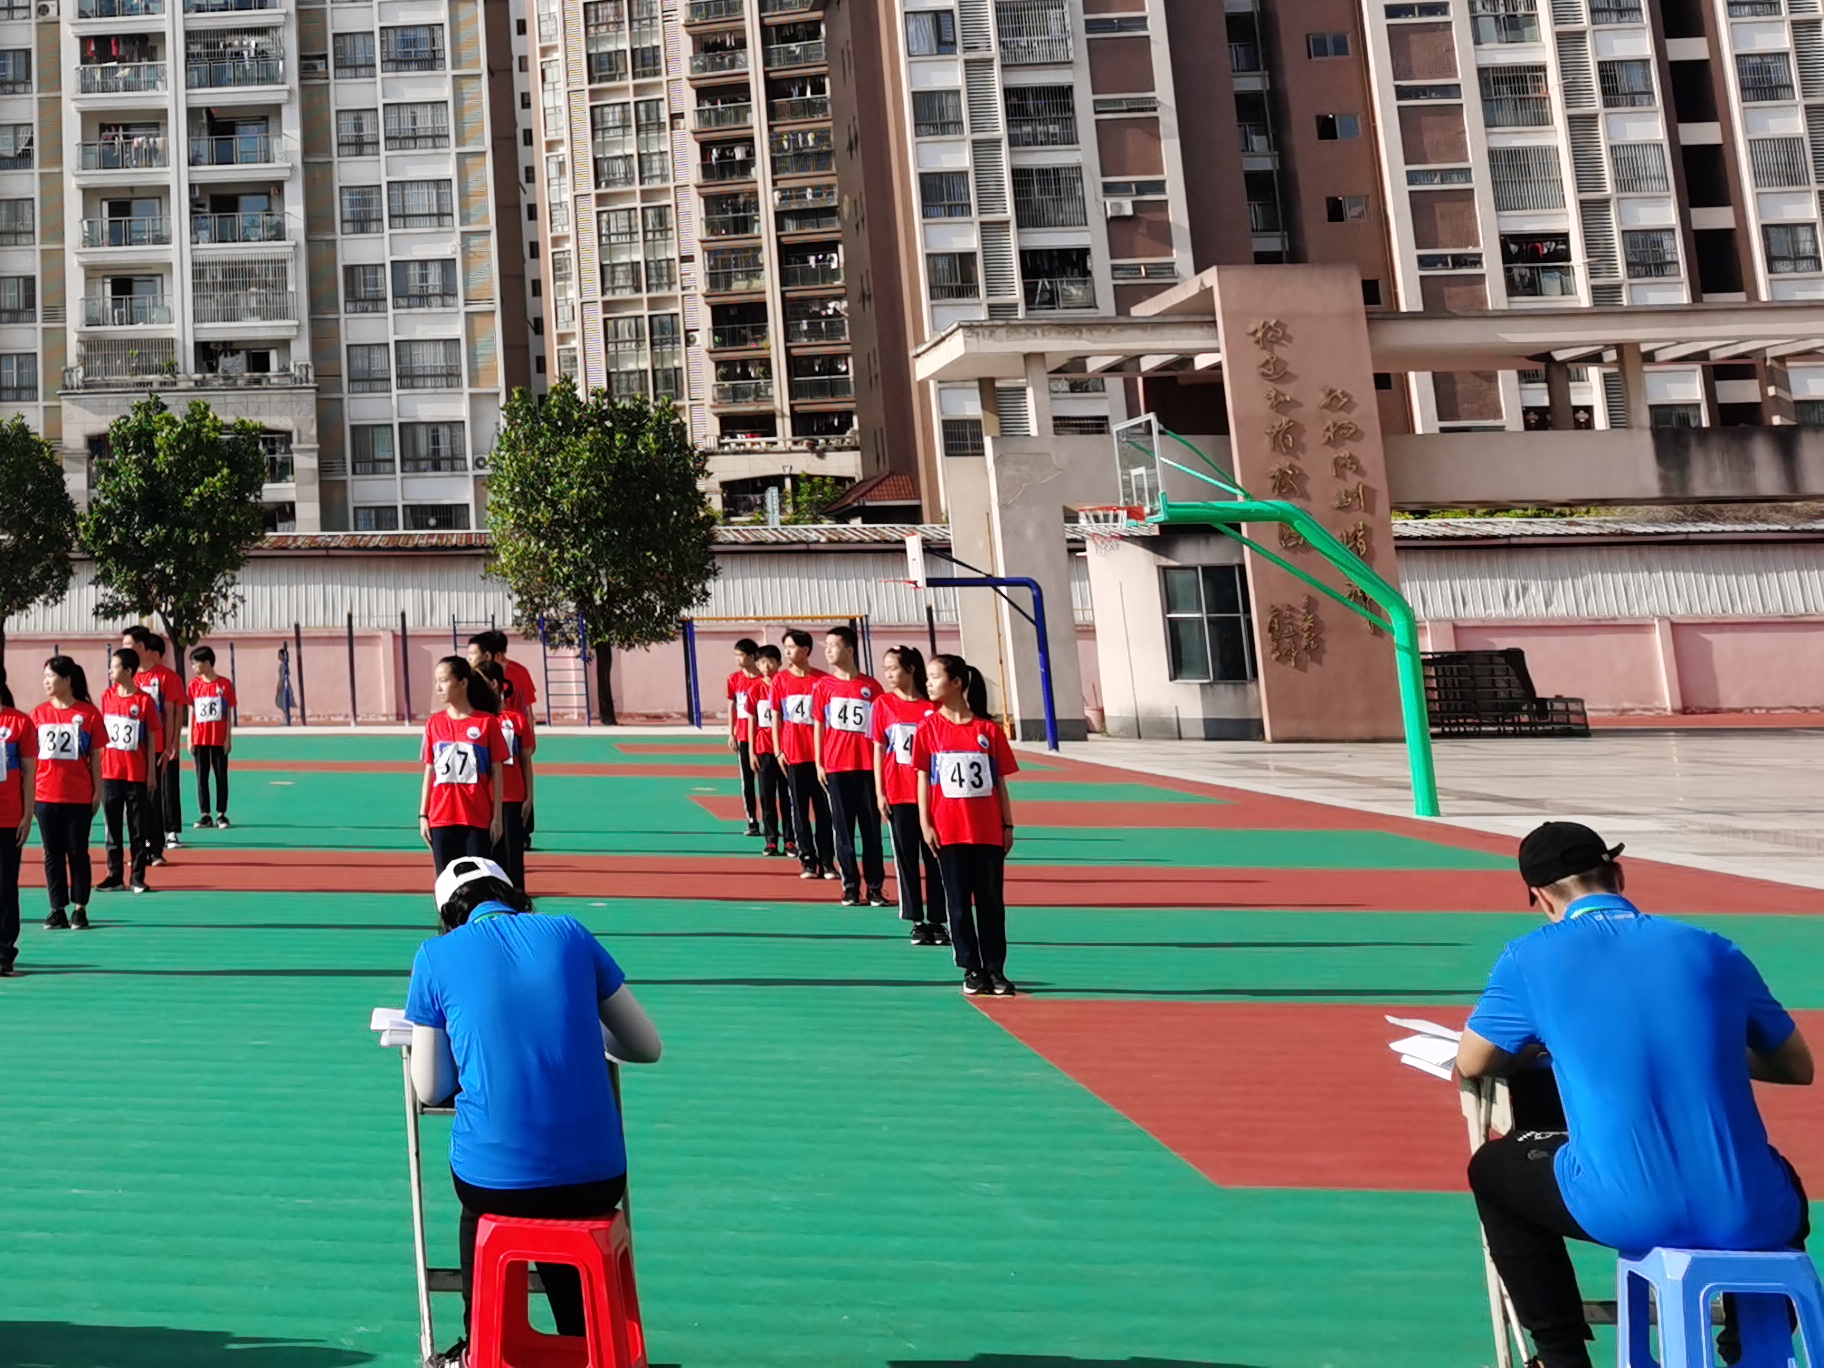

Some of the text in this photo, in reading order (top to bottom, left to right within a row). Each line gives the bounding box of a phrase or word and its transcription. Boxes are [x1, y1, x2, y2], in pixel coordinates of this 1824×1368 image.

[200, 702, 217, 717] 36
[838, 704, 864, 726] 45
[46, 731, 71, 753] 32
[111, 723, 133, 744] 33
[950, 761, 984, 789] 43
